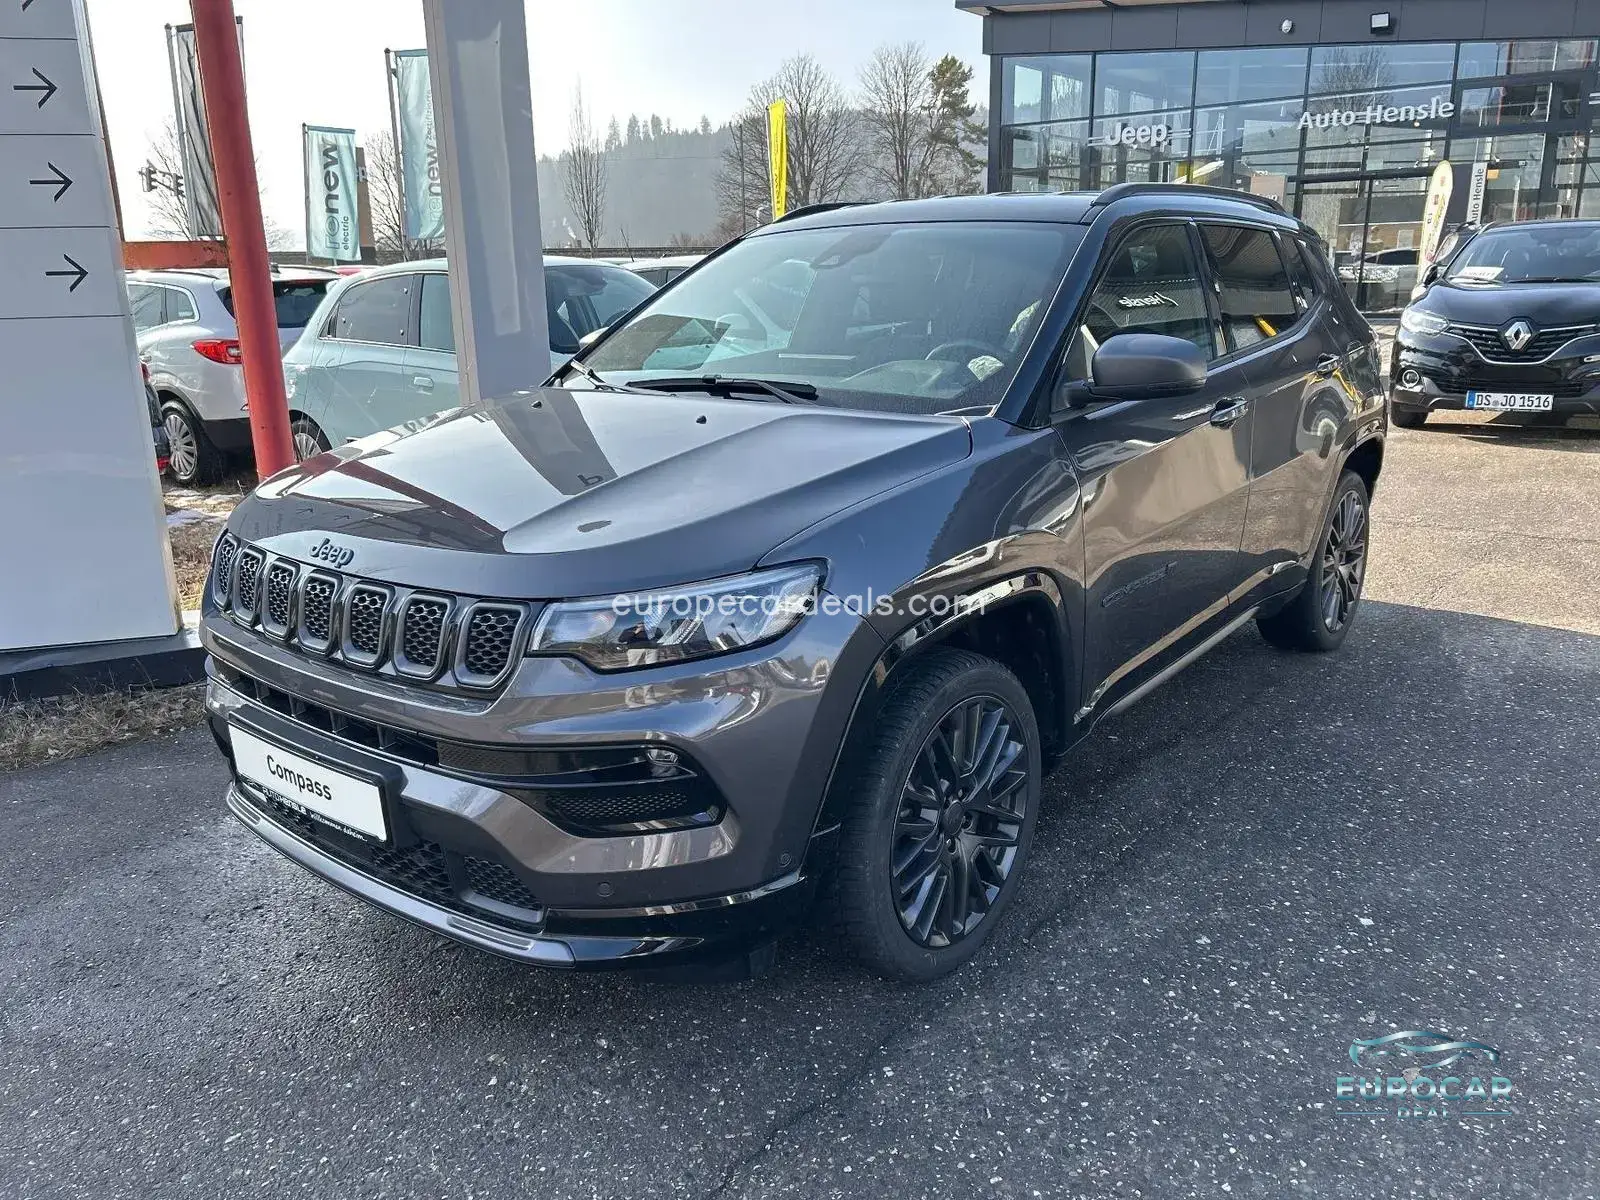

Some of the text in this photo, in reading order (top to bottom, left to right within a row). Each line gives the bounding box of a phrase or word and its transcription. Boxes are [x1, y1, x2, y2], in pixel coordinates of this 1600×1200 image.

[1298, 97, 1455, 130] Auto Hensle
[1104, 122, 1167, 147] Jeep
[323, 143, 340, 250] renew
[1473, 168, 1485, 201] Hensle
[341, 215, 349, 251] electric
[1476, 394, 1550, 408] DS JO 1516
[310, 538, 354, 568] Jeep
[267, 755, 332, 800] Compass
